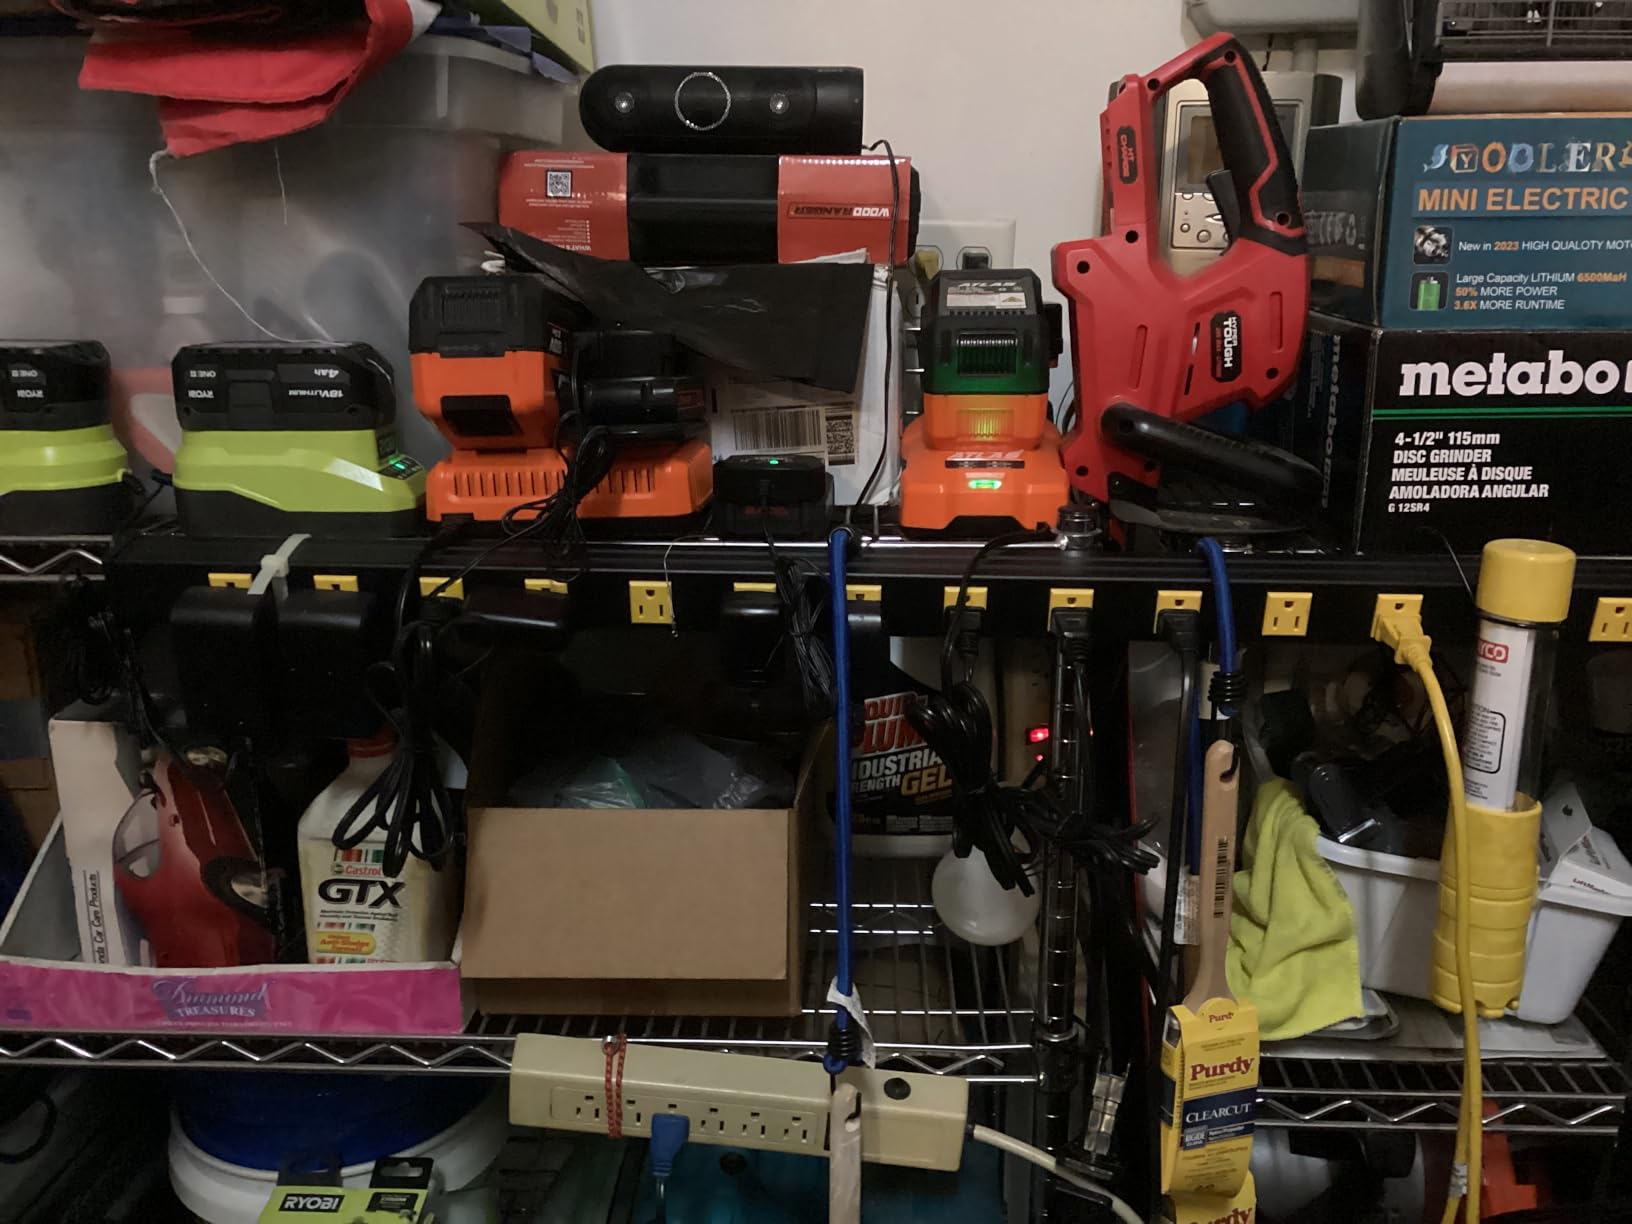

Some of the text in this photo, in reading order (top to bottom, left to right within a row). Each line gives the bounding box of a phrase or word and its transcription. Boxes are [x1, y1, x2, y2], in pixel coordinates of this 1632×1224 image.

[1418, 187, 1629, 211] MINI ELECTRIC
[1458, 241, 1481, 251] New
[1483, 241, 1491, 250] in
[1494, 241, 1519, 251] 2023
[1521, 240, 1549, 251] HIGH
[1551, 240, 1603, 251] QUALOTY
[1456, 273, 1484, 284] Large
[1486, 273, 1529, 284] Capacity
[1531, 272, 1575, 282] LITHIUM
[1455, 286, 1558, 297] 50% MORE POWER
[1453, 299, 1565, 310] 3.6X MORE RUNTIME
[1223, 317, 1233, 368] TOUGH
[314, 368, 340, 378] 4Ah
[1399, 350, 1621, 397] metabo
[16, 389, 44, 398] RYOBI
[187, 389, 215, 398] RYOBI
[1325, 335, 1341, 455] metabo
[1394, 431, 1501, 446] 4-1/2" 115mm
[1393, 449, 1492, 464] DISC GRINDER
[1391, 464, 1533, 482] MEULEUSE À DISQUE
[1389, 484, 1549, 499] AMOLADORA ANGULAR
[1388, 502, 1430, 513] G 12SR4
[848, 748, 943, 781] DUSTRIA
[901, 765, 953, 795] GEL
[346, 865, 382, 877] Castrol
[88, 873, 98, 907] Products
[318, 878, 406, 909] GTX
[91, 911, 101, 927] Care
[94, 930, 104, 943] Car
[176, 1006, 256, 1017] TREASURES
[1190, 1056, 1255, 1082] Purdy
[1185, 1103, 1252, 1124] CLEARCUT
[284, 1197, 340, 1210] RYOBI
